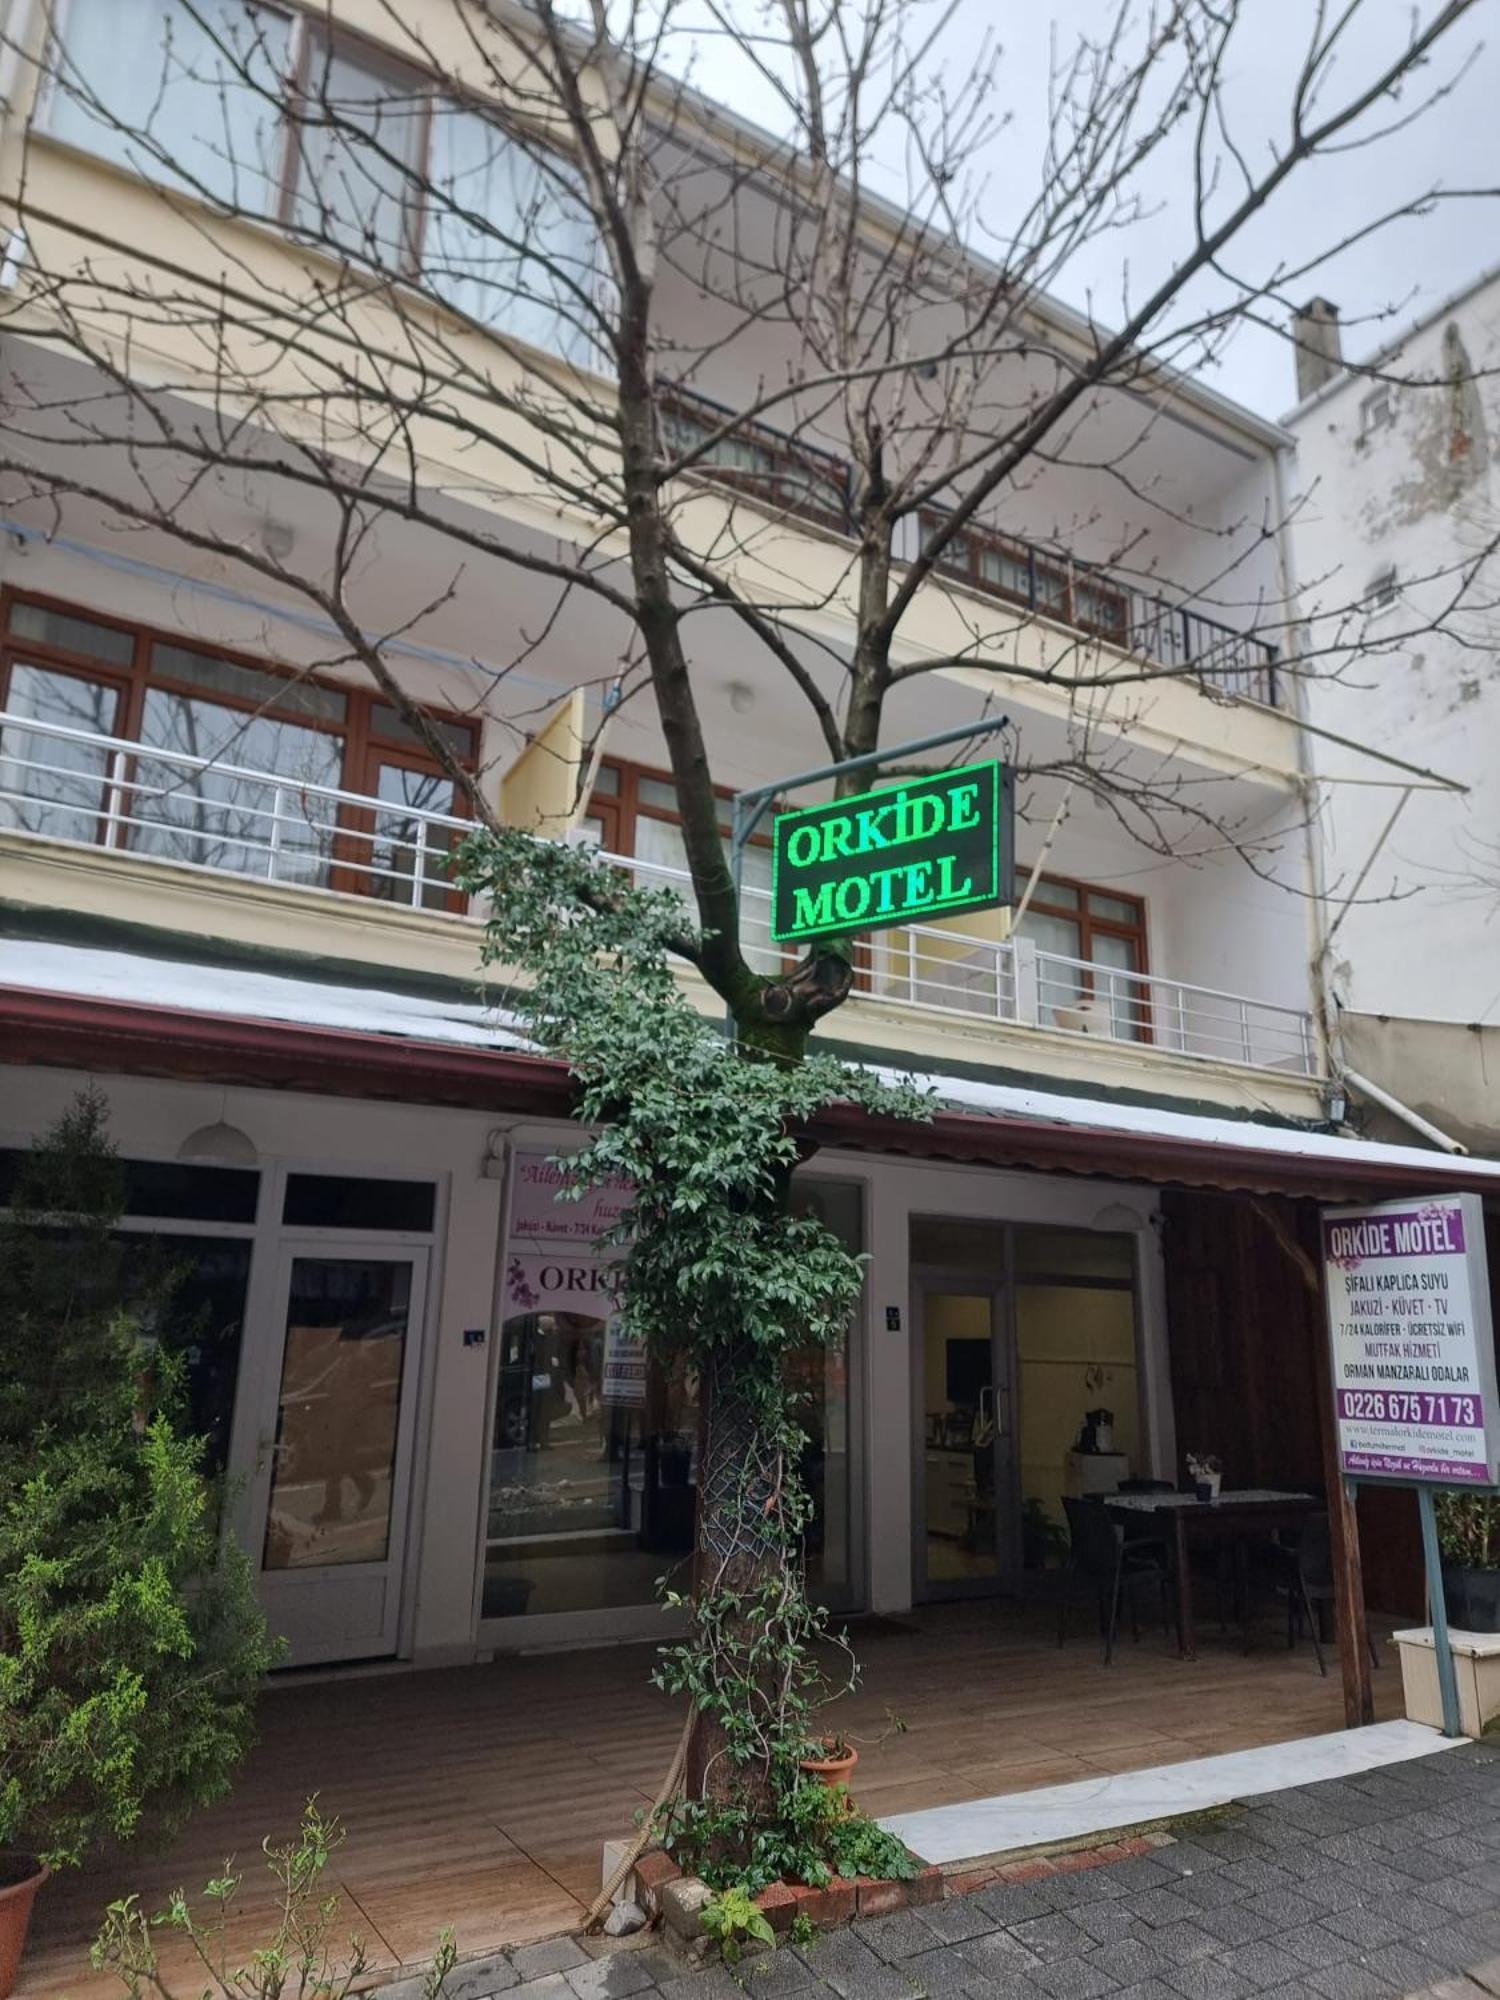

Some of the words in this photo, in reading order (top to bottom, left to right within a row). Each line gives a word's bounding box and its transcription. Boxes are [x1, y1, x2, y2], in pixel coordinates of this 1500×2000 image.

[788, 784, 980, 867] ORKİDE
[792, 855, 972, 929] MOTEL
[1330, 1219, 1391, 1257] ORKİDE
[1393, 1215, 1456, 1253] MOTEL
[1345, 1273, 1374, 1294] ŞİFALI
[1376, 1273, 1419, 1292] KAPLICA
[1420, 1273, 1449, 1290] SUYU
[1350, 1296, 1383, 1316] JAKUZİ
[1391, 1297, 1424, 1316] KÜVET
[1434, 1298, 1448, 1316] TV
[1339, 1323, 1359, 1336] 7/24
[1359, 1321, 1401, 1336] KALORİFER
[1407, 1321, 1446, 1336] ÜCRETSİZ
[1364, 1343, 1401, 1358] MUTFAK
[1403, 1341, 1441, 1358] HİZMETİ
[1343, 1364, 1374, 1379] ORMAN
[1376, 1364, 1430, 1381] MANZARALI
[1431, 1366, 1469, 1382] ODALAR
[1343, 1392, 1385, 1419] 0226
[1388, 1394, 1421, 1421] 675
[1425, 1396, 1447, 1423] 71
[1450, 1397, 1475, 1425] 73
[1345, 1424, 1477, 1443] www.termalorkidemotel.com
